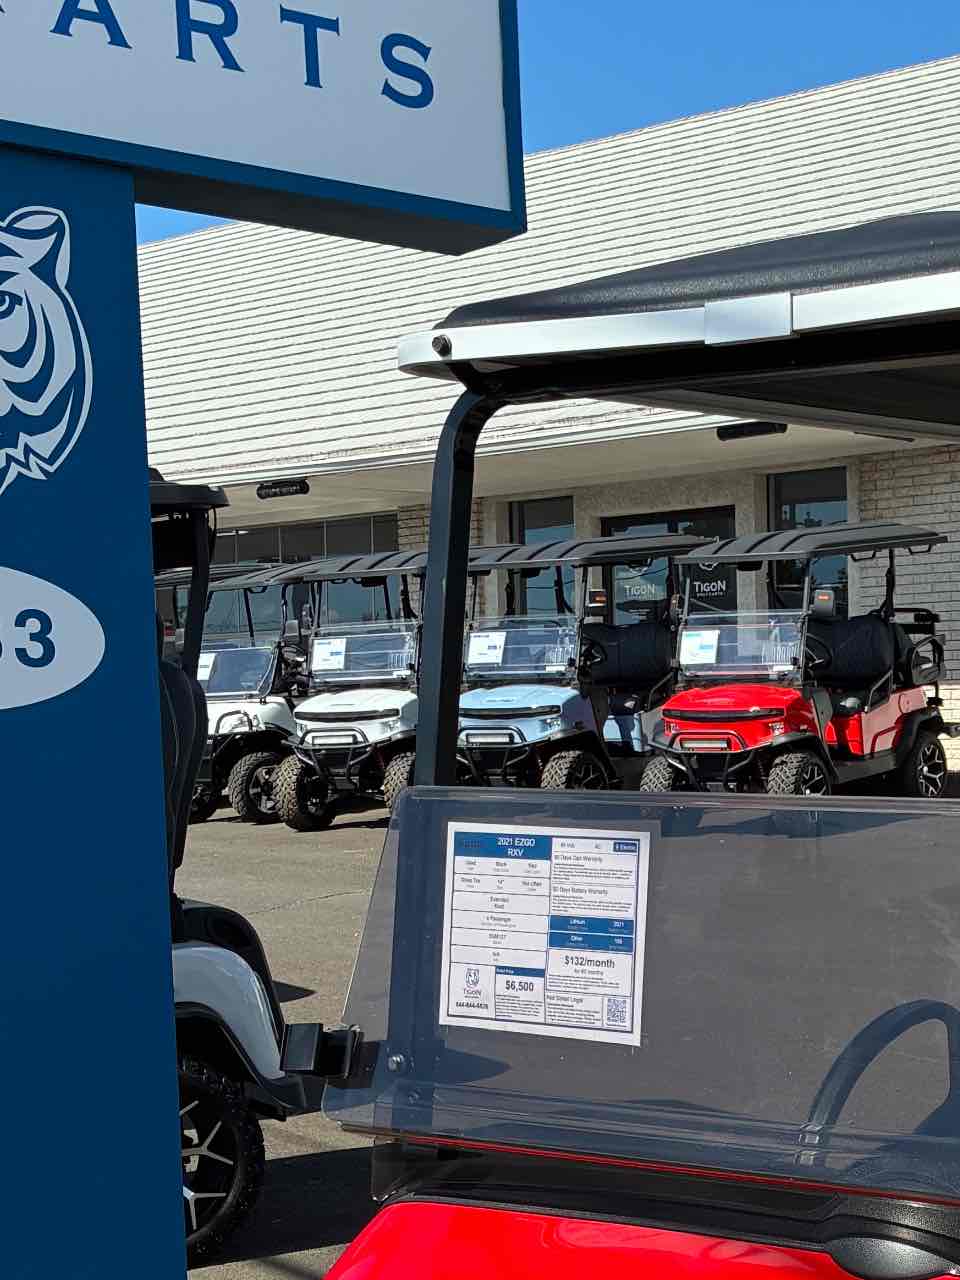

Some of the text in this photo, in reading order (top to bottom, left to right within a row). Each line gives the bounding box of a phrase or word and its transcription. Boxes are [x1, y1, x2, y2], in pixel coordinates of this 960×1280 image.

[0, 0, 435, 109] ARTS
[623, 583, 655, 595] TIGON
[693, 580, 726, 592] TIGON
[0, 608, 56, 668] 3
[497, 837, 536, 848] 2021 EZGO
[507, 848, 524, 857] RXV
[564, 955, 615, 969] $132/month
[505, 980, 534, 992] $6,500
